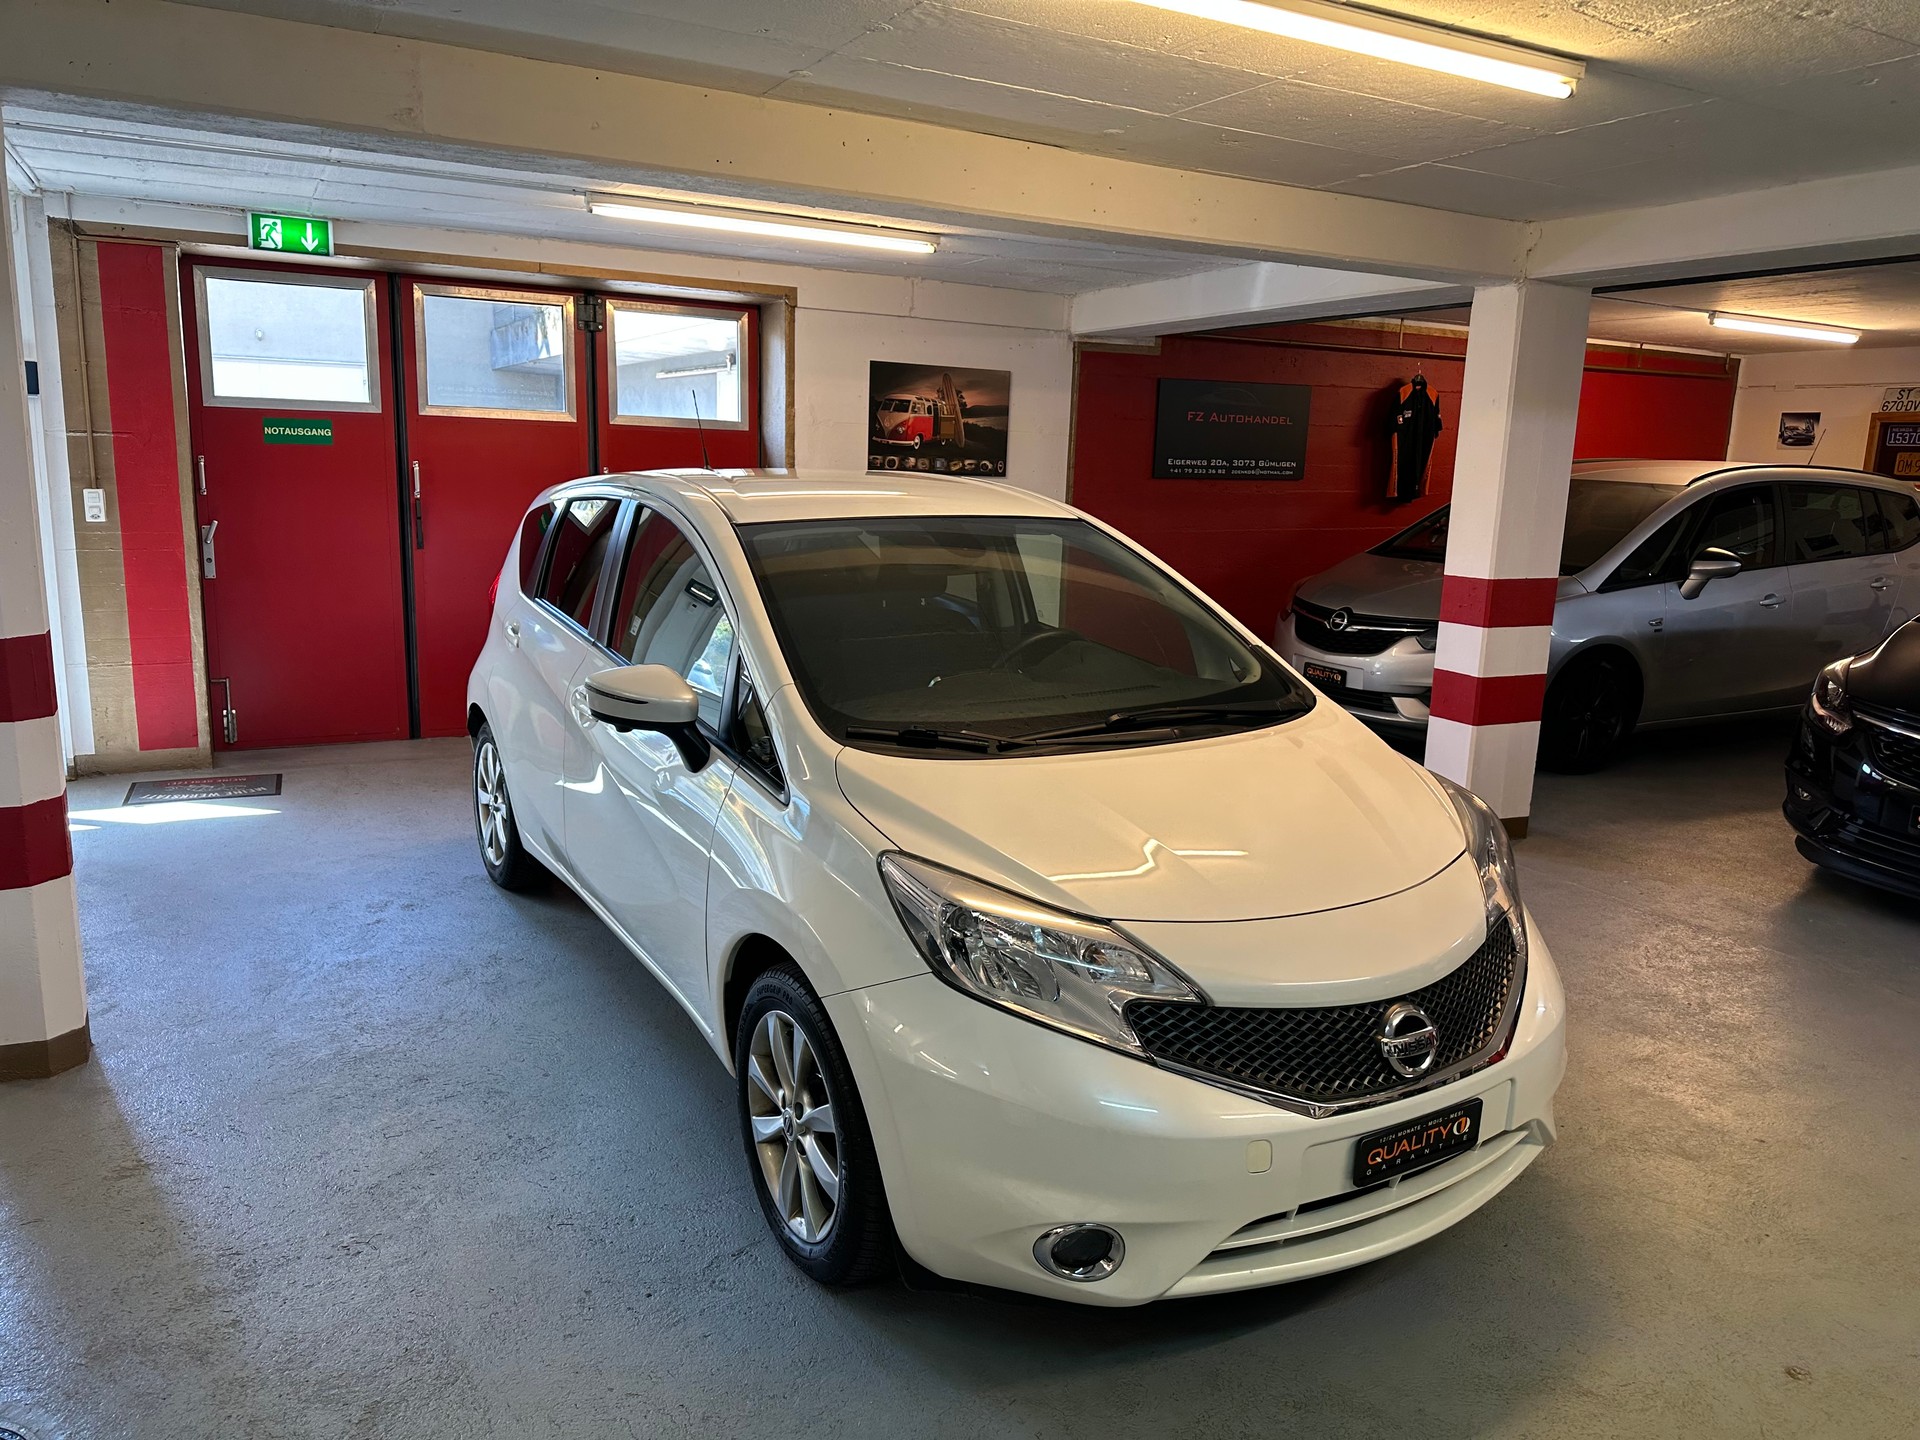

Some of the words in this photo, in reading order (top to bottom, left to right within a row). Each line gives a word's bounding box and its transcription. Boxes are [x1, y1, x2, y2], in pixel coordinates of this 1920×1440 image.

[1896, 389, 1913, 400] ST
[1187, 411, 1205, 422] FZ
[264, 426, 332, 437] NOTAUSGANG
